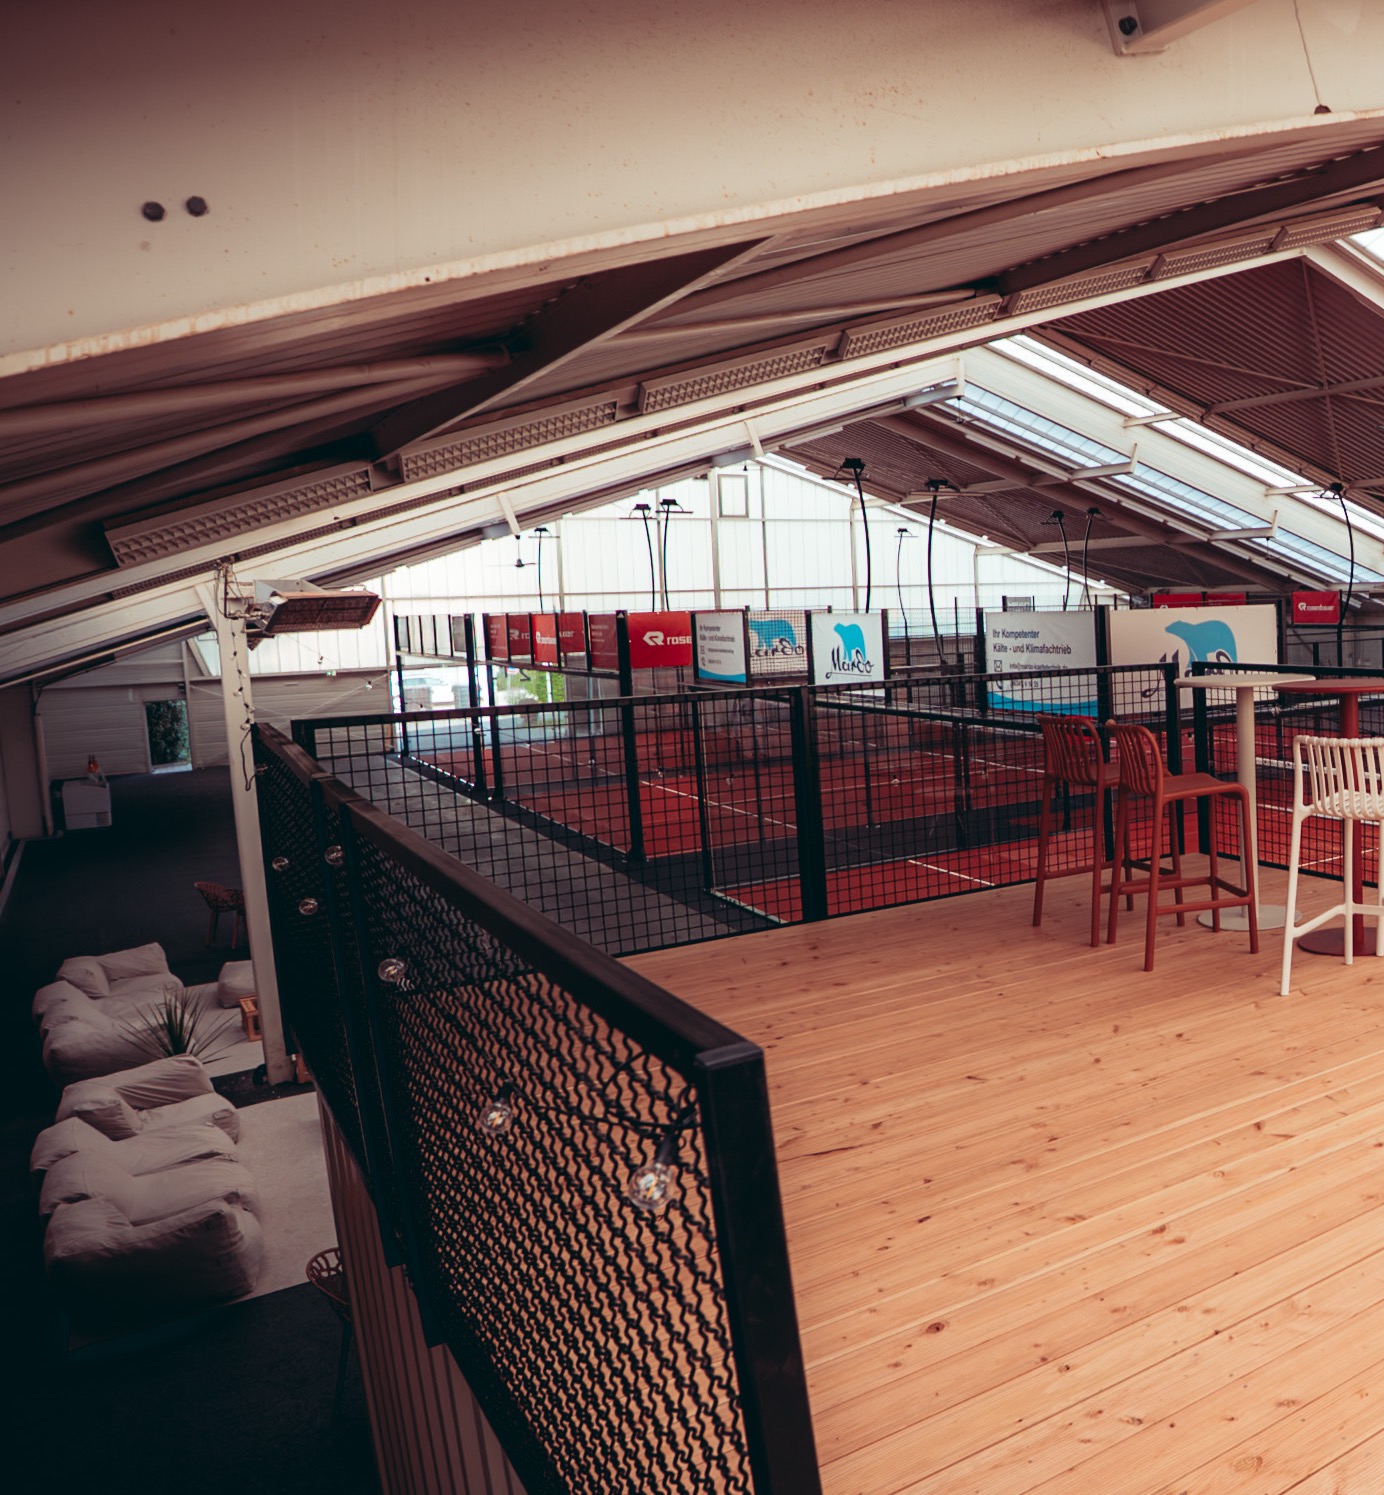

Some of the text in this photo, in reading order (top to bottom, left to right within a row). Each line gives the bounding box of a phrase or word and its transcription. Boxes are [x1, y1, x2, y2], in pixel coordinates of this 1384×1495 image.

[993, 629, 1040, 640] Ihr Kompetenter
[1013, 644, 1025, 654] und
